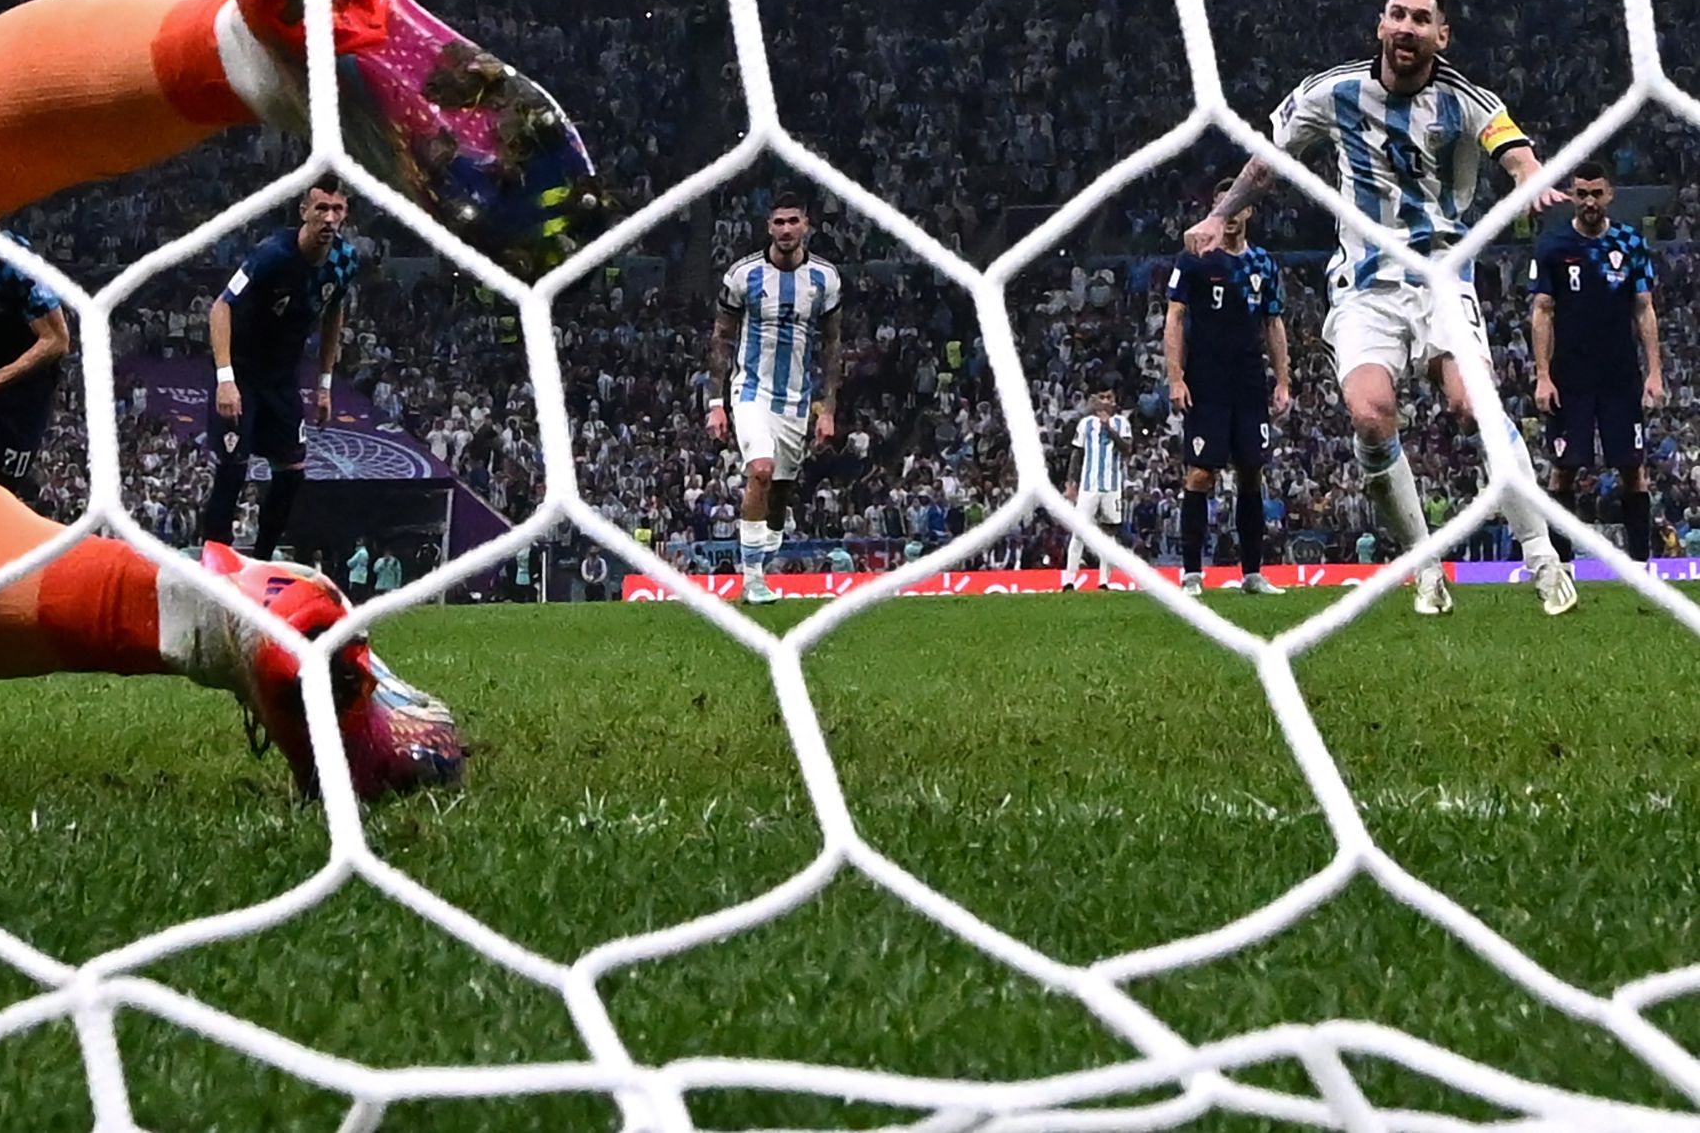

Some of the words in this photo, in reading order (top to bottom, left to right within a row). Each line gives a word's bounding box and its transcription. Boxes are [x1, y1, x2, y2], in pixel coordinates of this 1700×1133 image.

[1568, 265, 1581, 292] 8
[1211, 285, 1225, 310] 9
[1259, 422, 1269, 449] 9
[1633, 422, 1643, 450] 8
[3, 447, 32, 478] 20
